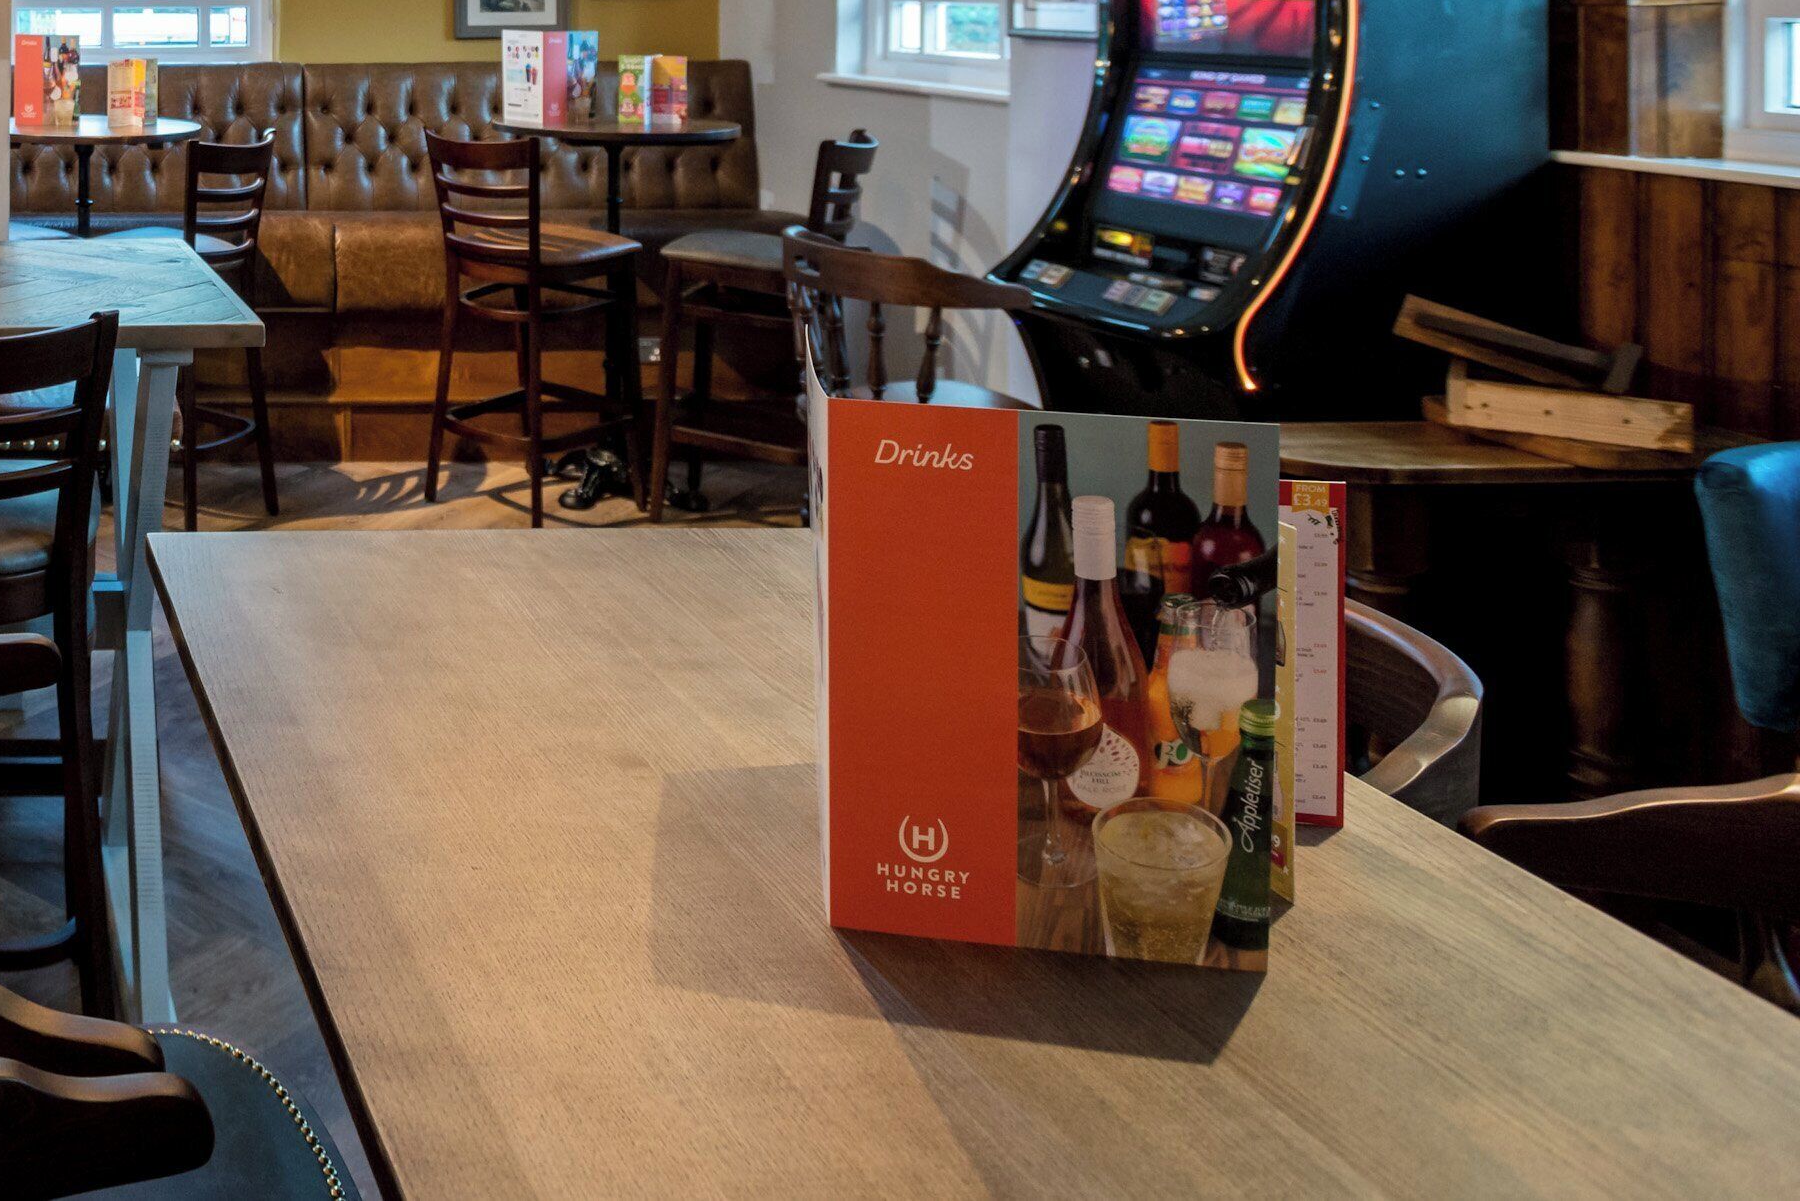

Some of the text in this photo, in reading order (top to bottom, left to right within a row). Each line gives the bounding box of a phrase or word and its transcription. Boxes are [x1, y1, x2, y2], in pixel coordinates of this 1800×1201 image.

[874, 439, 975, 470] Drinks
[1295, 484, 1326, 493] FROM
[1230, 756, 1265, 854] Appletiser
[912, 825, 935, 851] H
[876, 862, 970, 885] HUNGRY
[886, 879, 961, 899] HORSE
